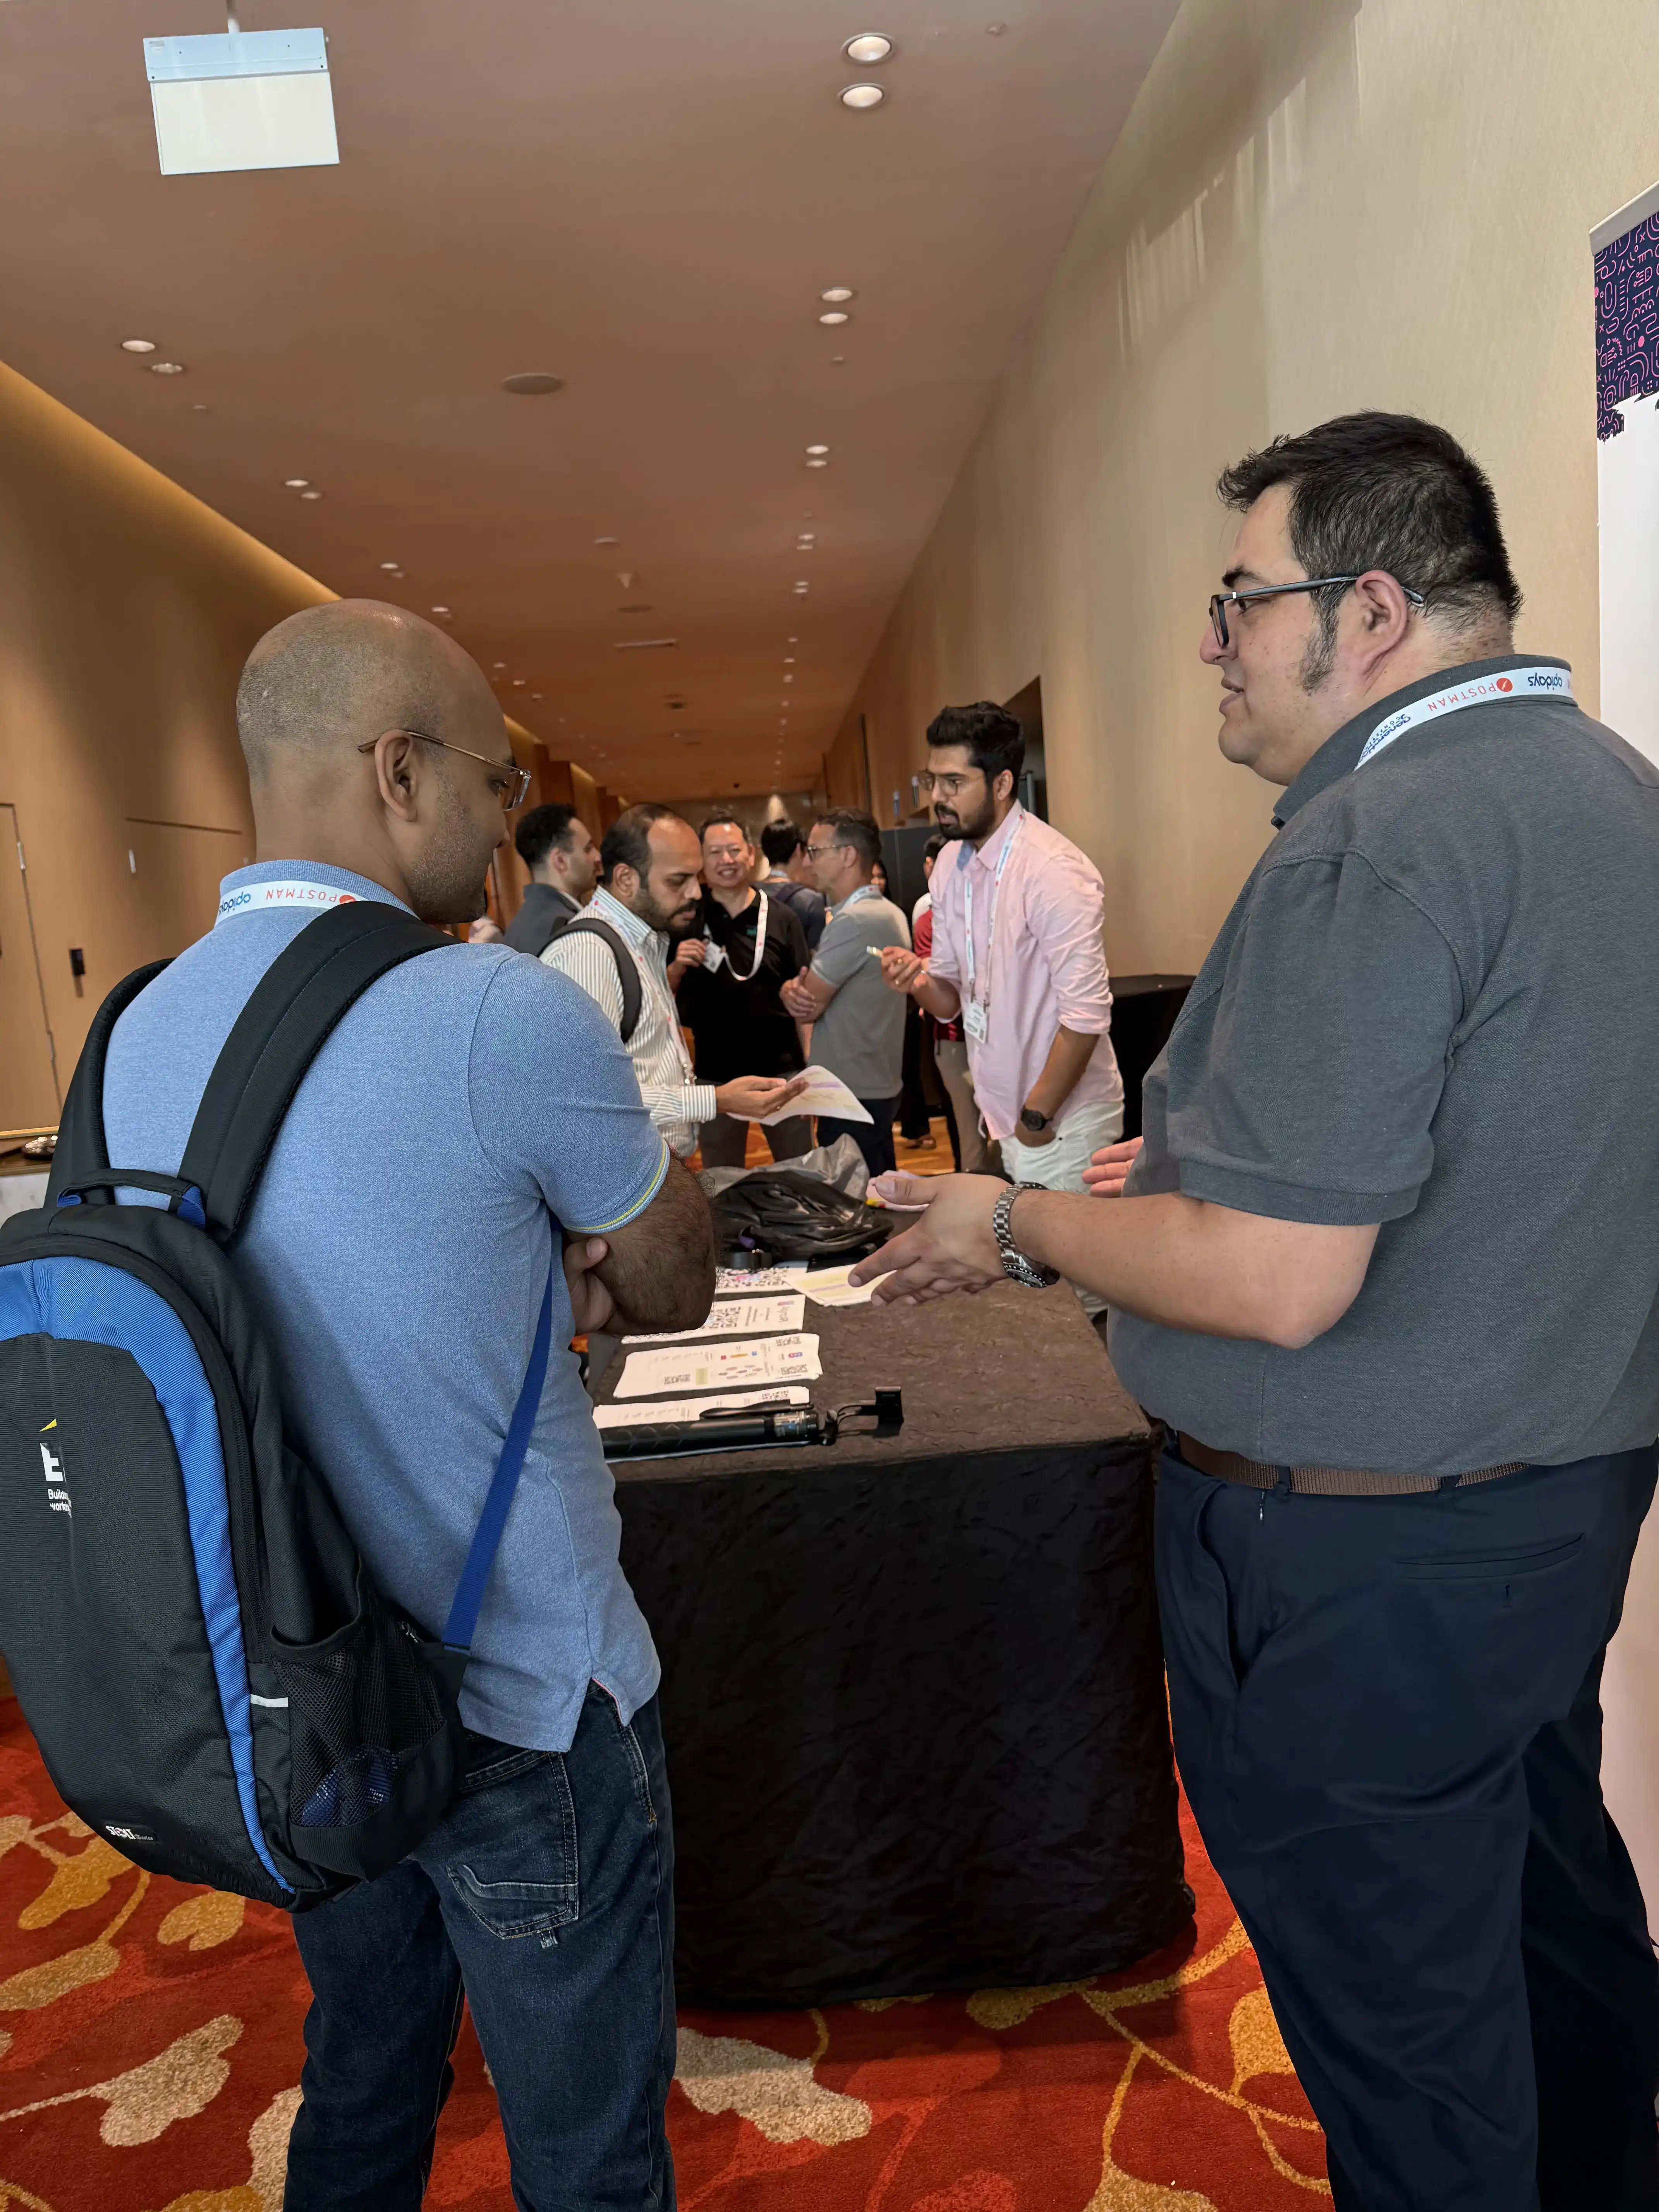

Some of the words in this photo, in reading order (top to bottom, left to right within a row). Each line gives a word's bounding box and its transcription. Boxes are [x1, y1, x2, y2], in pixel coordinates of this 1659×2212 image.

[1528, 672, 1563, 690] apidays
[1427, 683, 1496, 711] POSTMAN
[266, 888, 337, 903] POSTMAN
